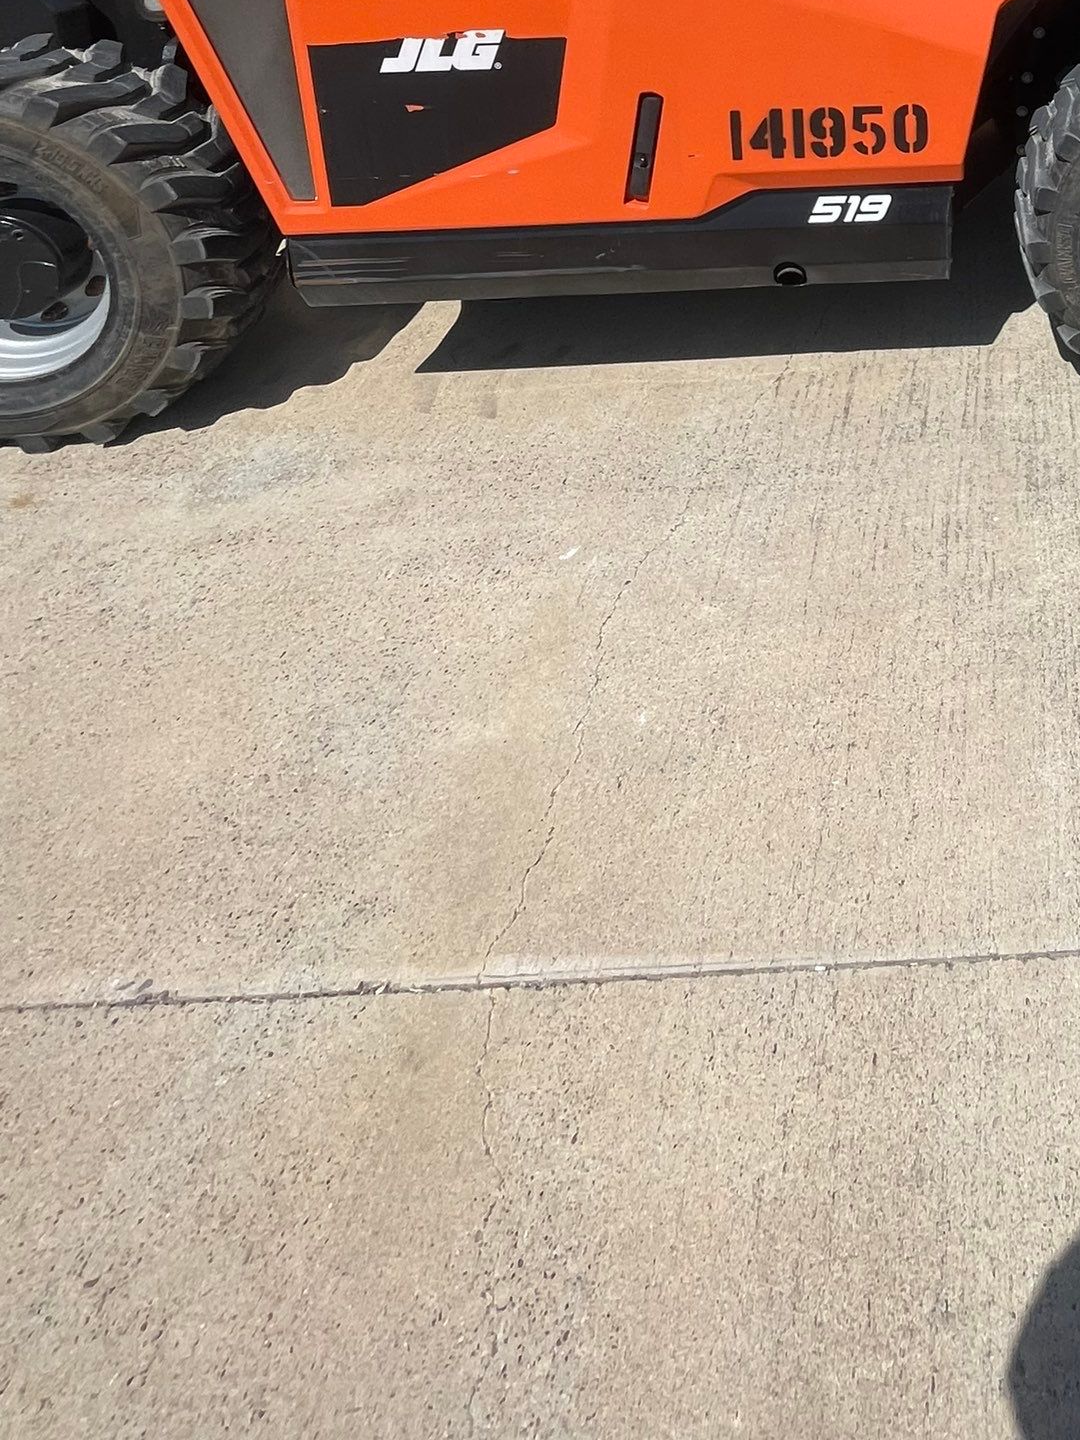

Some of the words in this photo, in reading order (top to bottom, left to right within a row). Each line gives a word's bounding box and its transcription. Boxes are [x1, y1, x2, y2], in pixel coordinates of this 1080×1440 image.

[379, 29, 505, 73] JLG
[730, 104, 928, 160] 141950
[807, 194, 893, 224] 519
